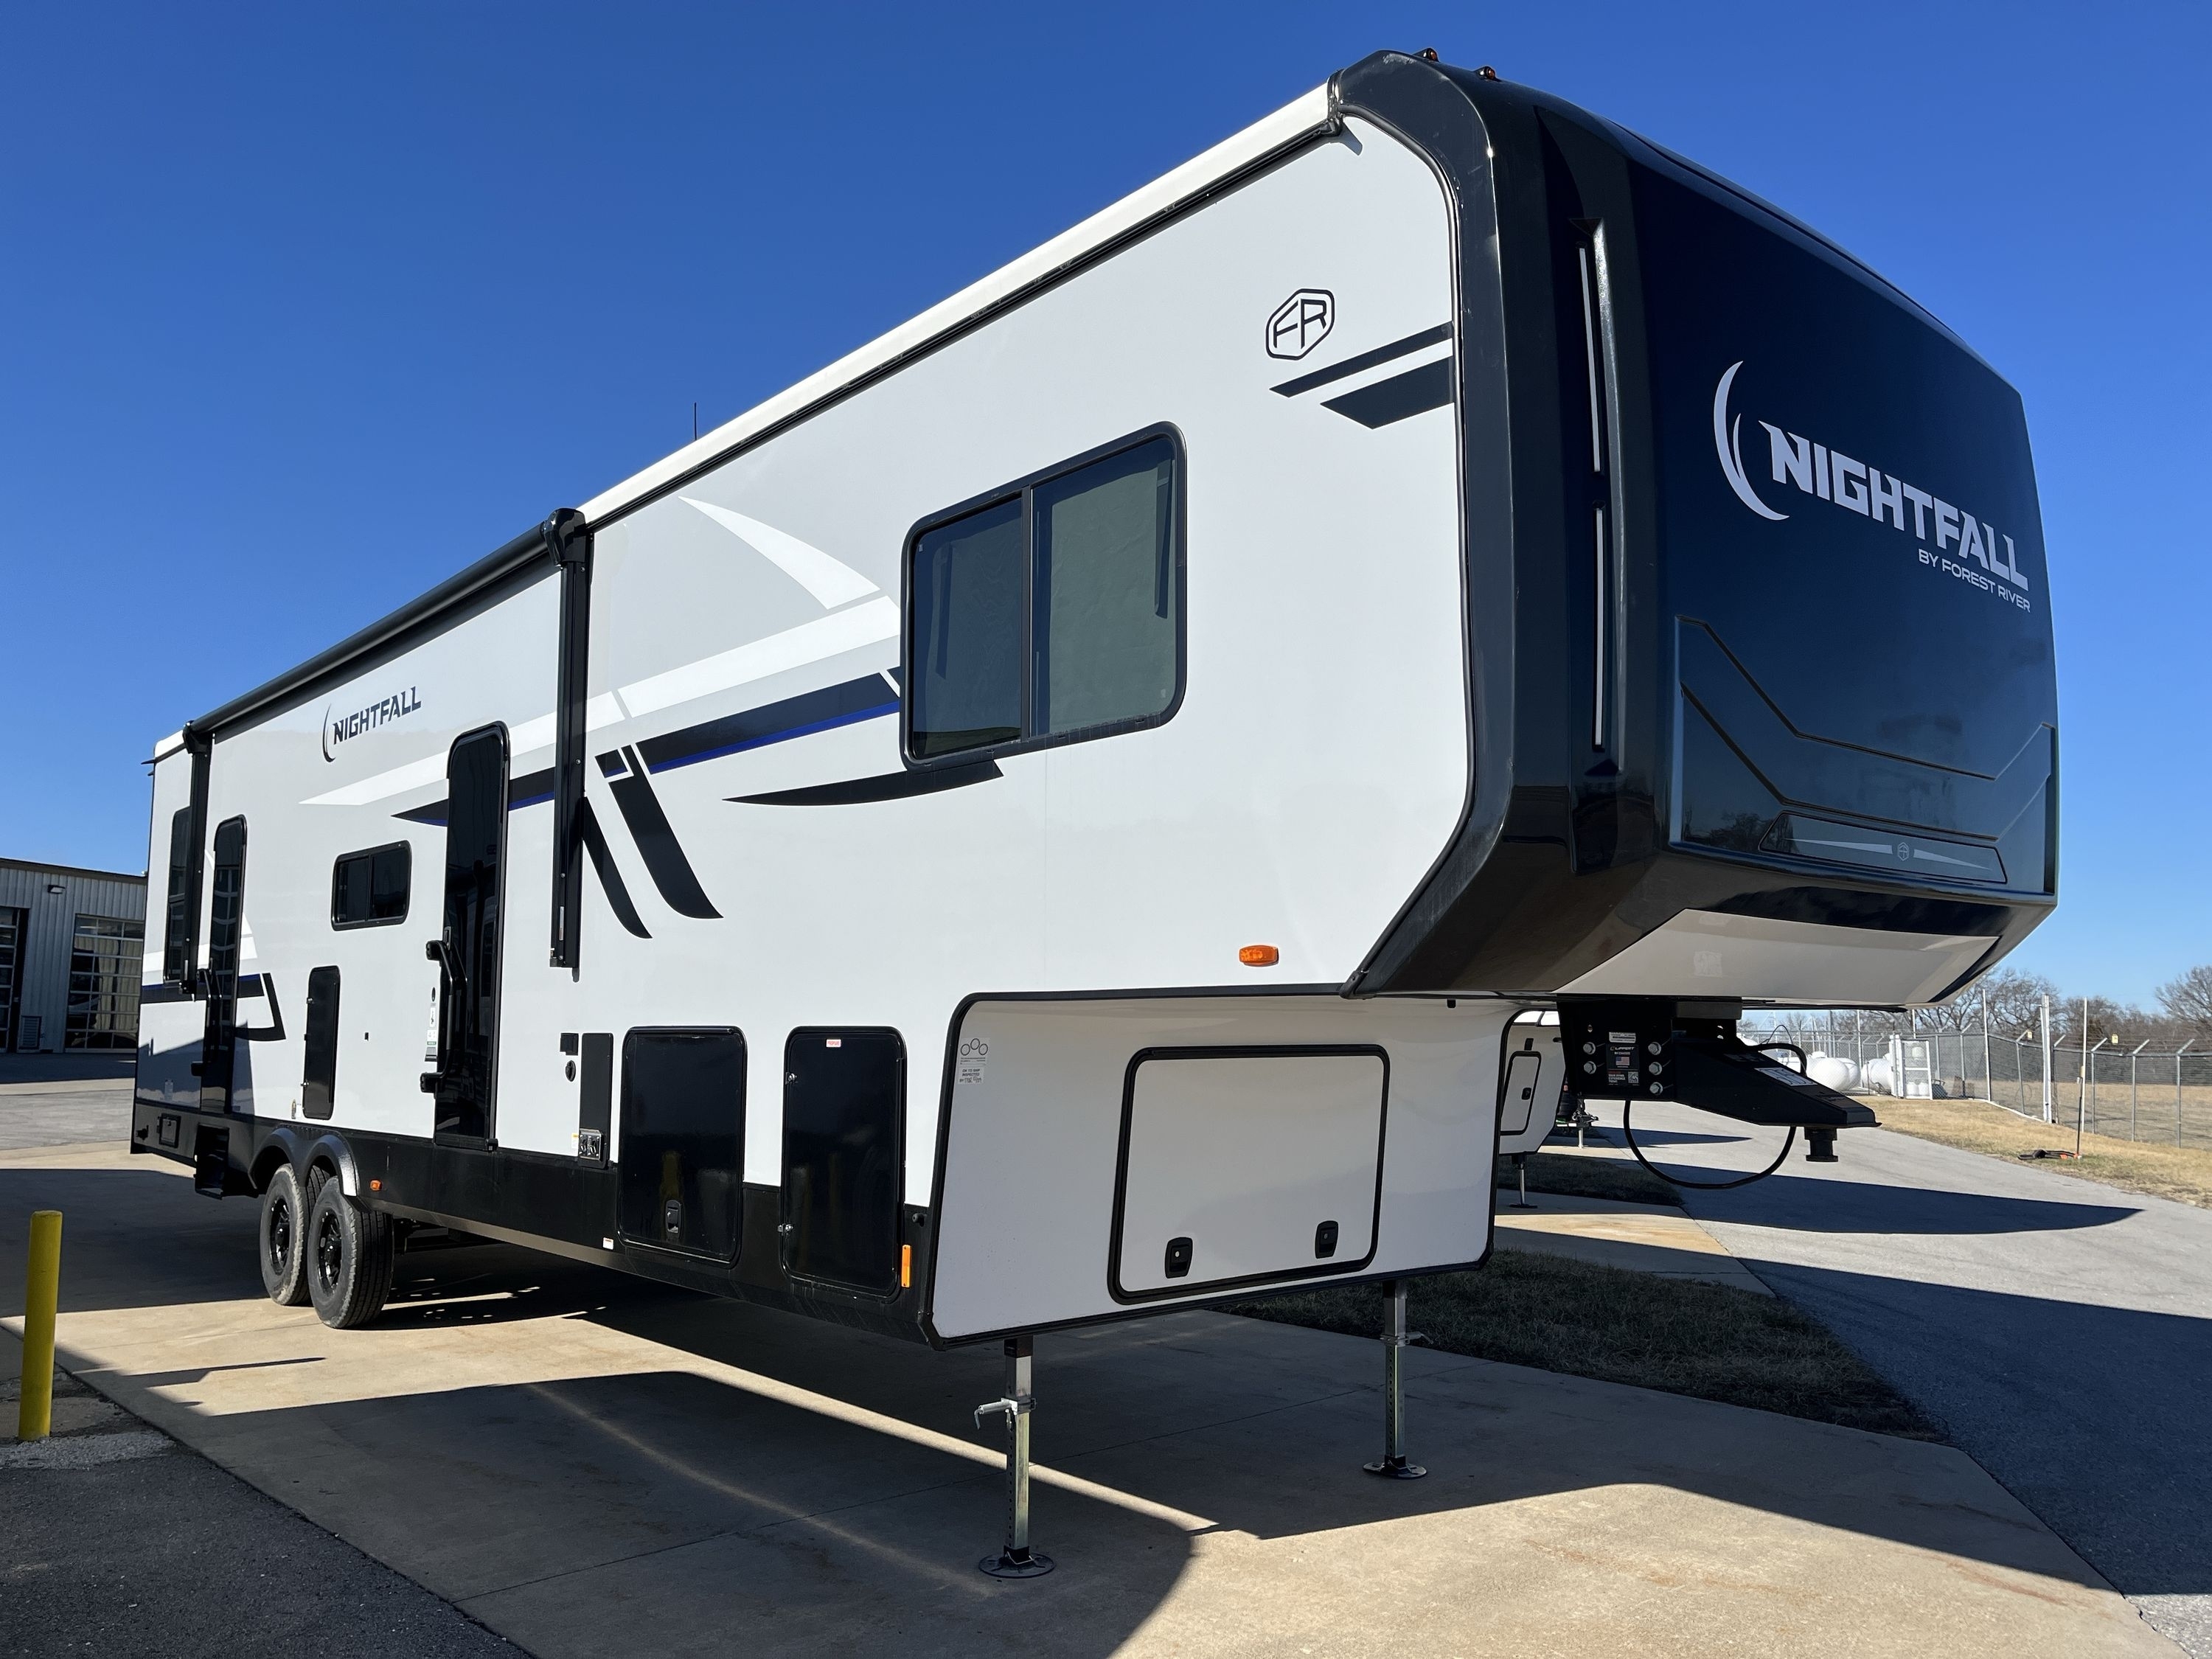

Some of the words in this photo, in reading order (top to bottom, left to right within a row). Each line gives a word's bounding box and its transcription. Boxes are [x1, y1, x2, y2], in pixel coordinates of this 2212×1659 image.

[1758, 420, 2029, 591] NIGHTFALL
[1918, 548, 1939, 568] BY
[1941, 557, 1996, 594] FOREST
[1997, 584, 2031, 613] RIVER
[332, 685, 422, 745] NIGHTFALL
